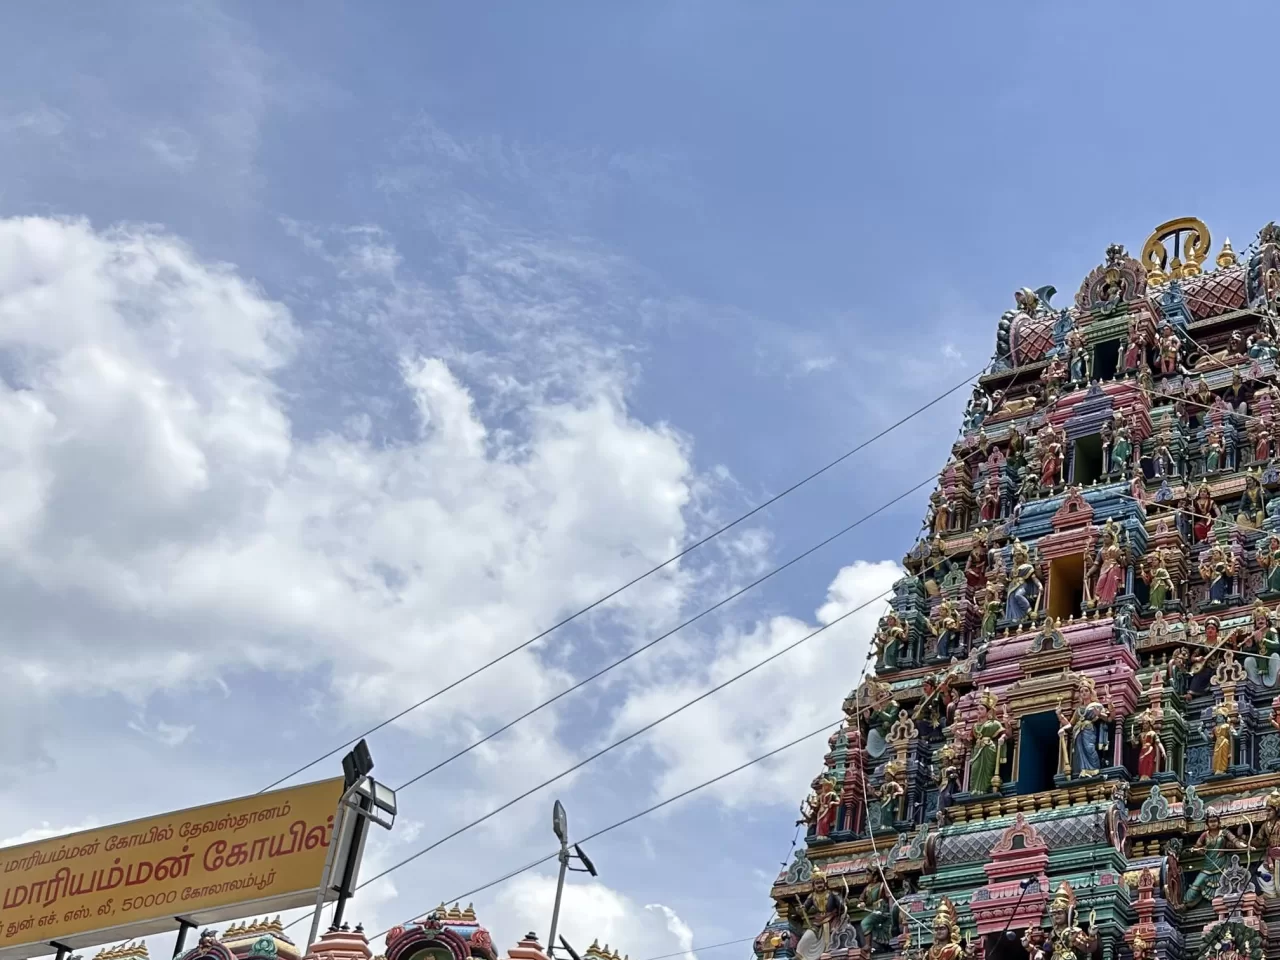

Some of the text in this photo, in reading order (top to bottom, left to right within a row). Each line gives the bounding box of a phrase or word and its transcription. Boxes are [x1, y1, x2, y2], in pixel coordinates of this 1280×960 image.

[2, 815, 334, 909] மாரியம்மன் கோயில்
[4, 838, 101, 873] மாரியம்மன்
[104, 824, 174, 852] கோயில்
[5, 915, 35, 938] துன்
[121, 890, 177, 912] 50000
[181, 868, 277, 901] கோலாலம்பூர்
